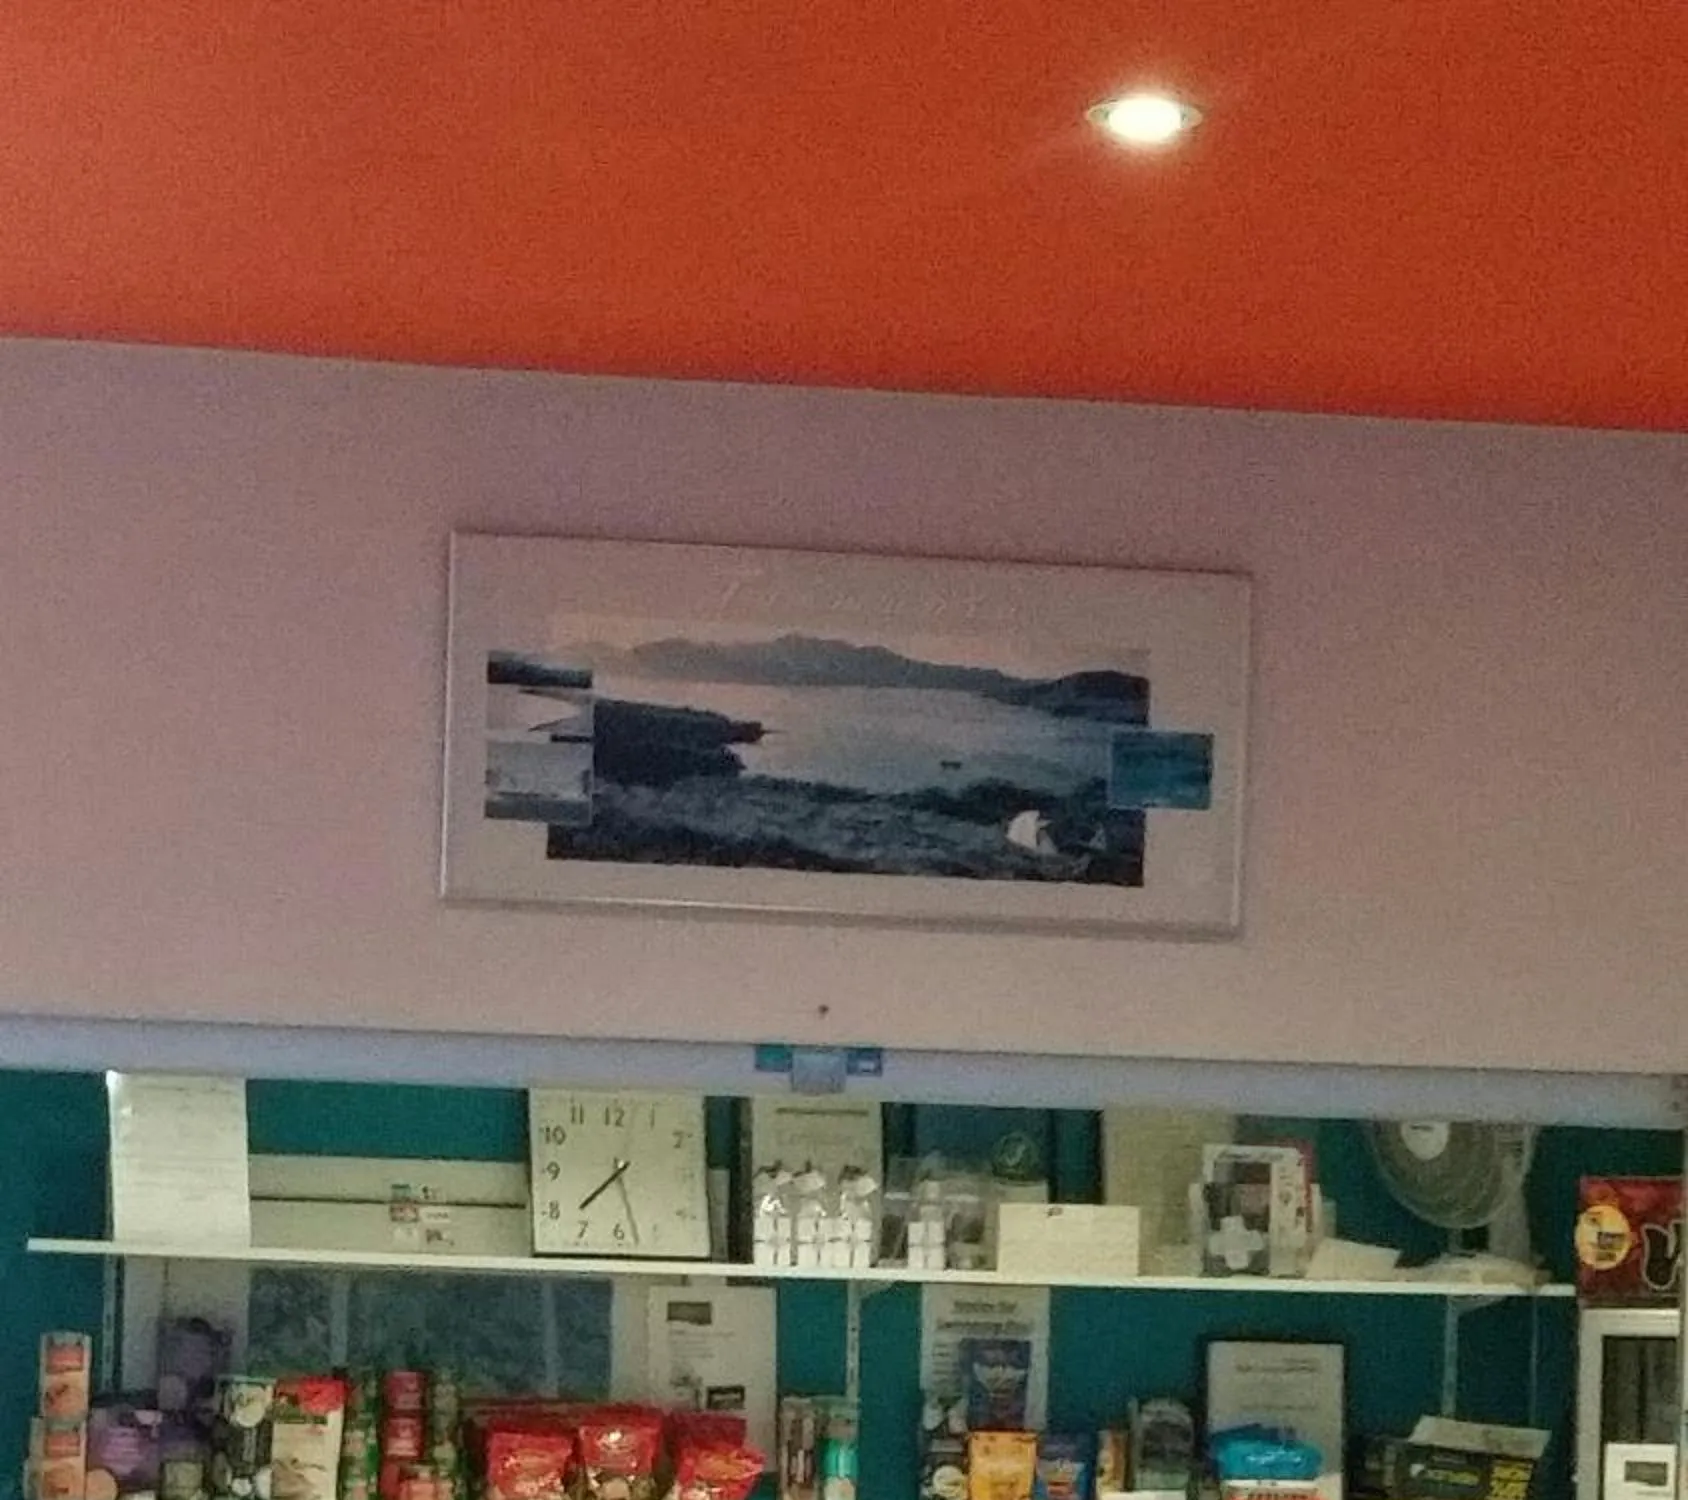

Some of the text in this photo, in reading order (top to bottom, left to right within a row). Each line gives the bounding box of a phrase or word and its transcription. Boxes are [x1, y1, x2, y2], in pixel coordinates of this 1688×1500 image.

[571, 1104, 585, 1124] 11
[605, 1106, 625, 1127] 12
[544, 1126, 567, 1145] 10
[546, 1161, 561, 1181] 9
[548, 1202, 561, 1220] 8
[577, 1220, 589, 1239] 7
[612, 1223, 625, 1241] 6
